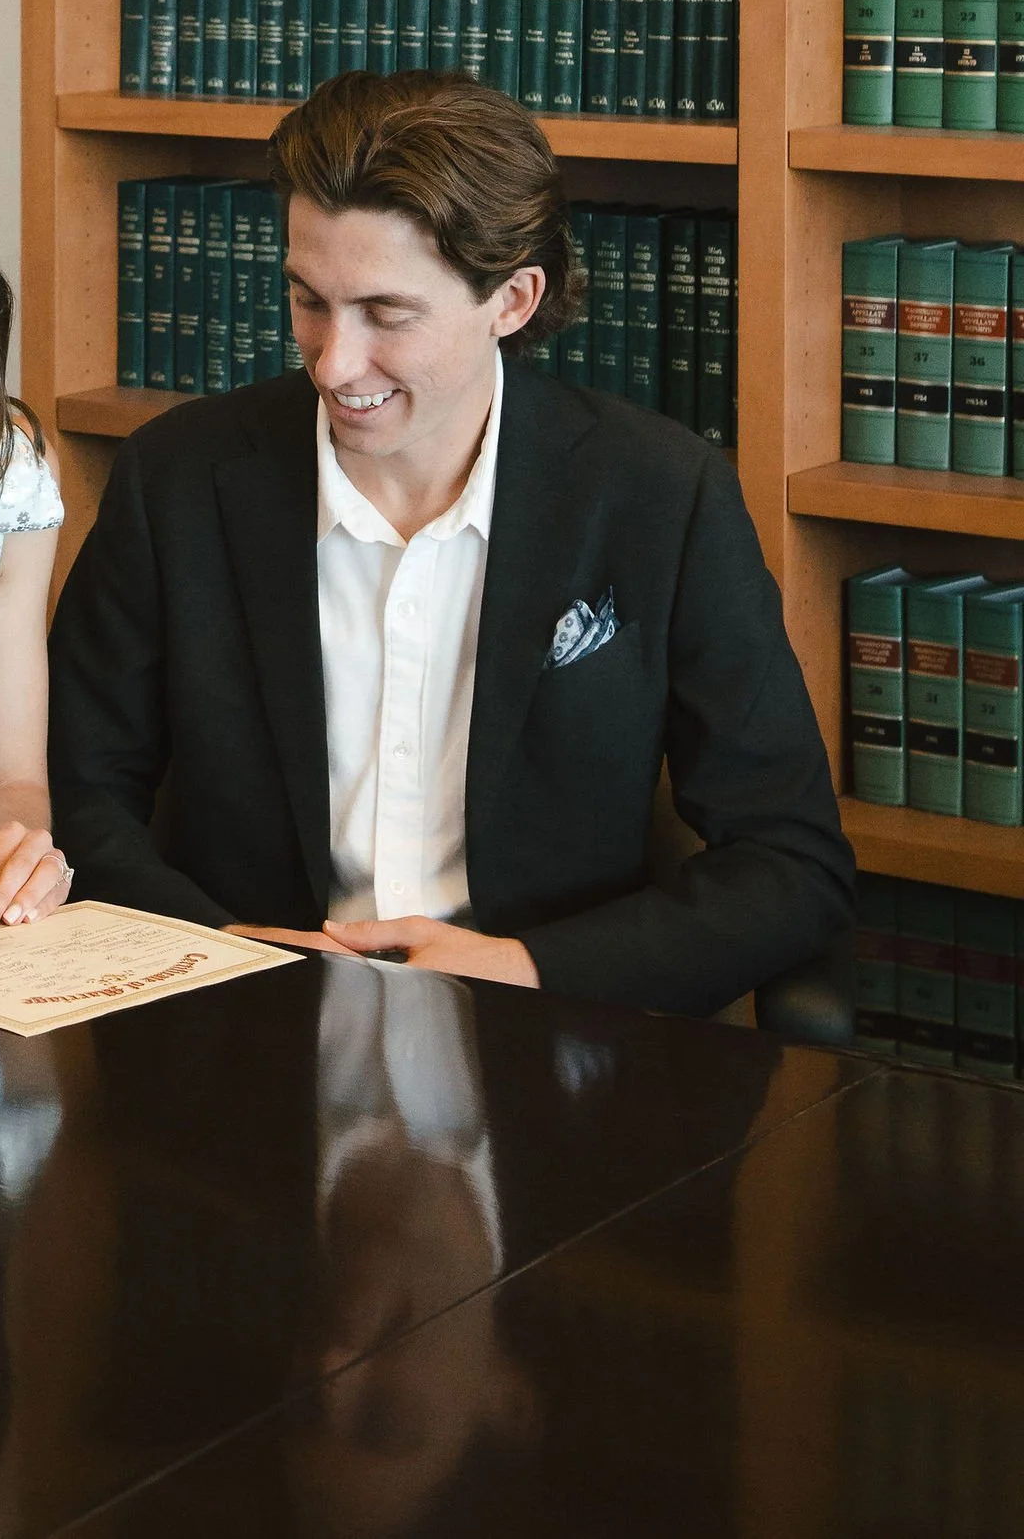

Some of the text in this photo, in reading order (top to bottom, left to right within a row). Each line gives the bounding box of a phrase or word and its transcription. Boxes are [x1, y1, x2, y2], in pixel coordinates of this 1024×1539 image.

[858, 7, 874, 17] 20
[912, 8, 925, 19] 21
[960, 12, 976, 22] 22
[959, 310, 999, 319] WASHINGTON
[860, 347, 875, 357] 35
[914, 352, 929, 362] 37
[969, 356, 985, 366] 36
[21, 952, 209, 1005] Certificate of Marriage
